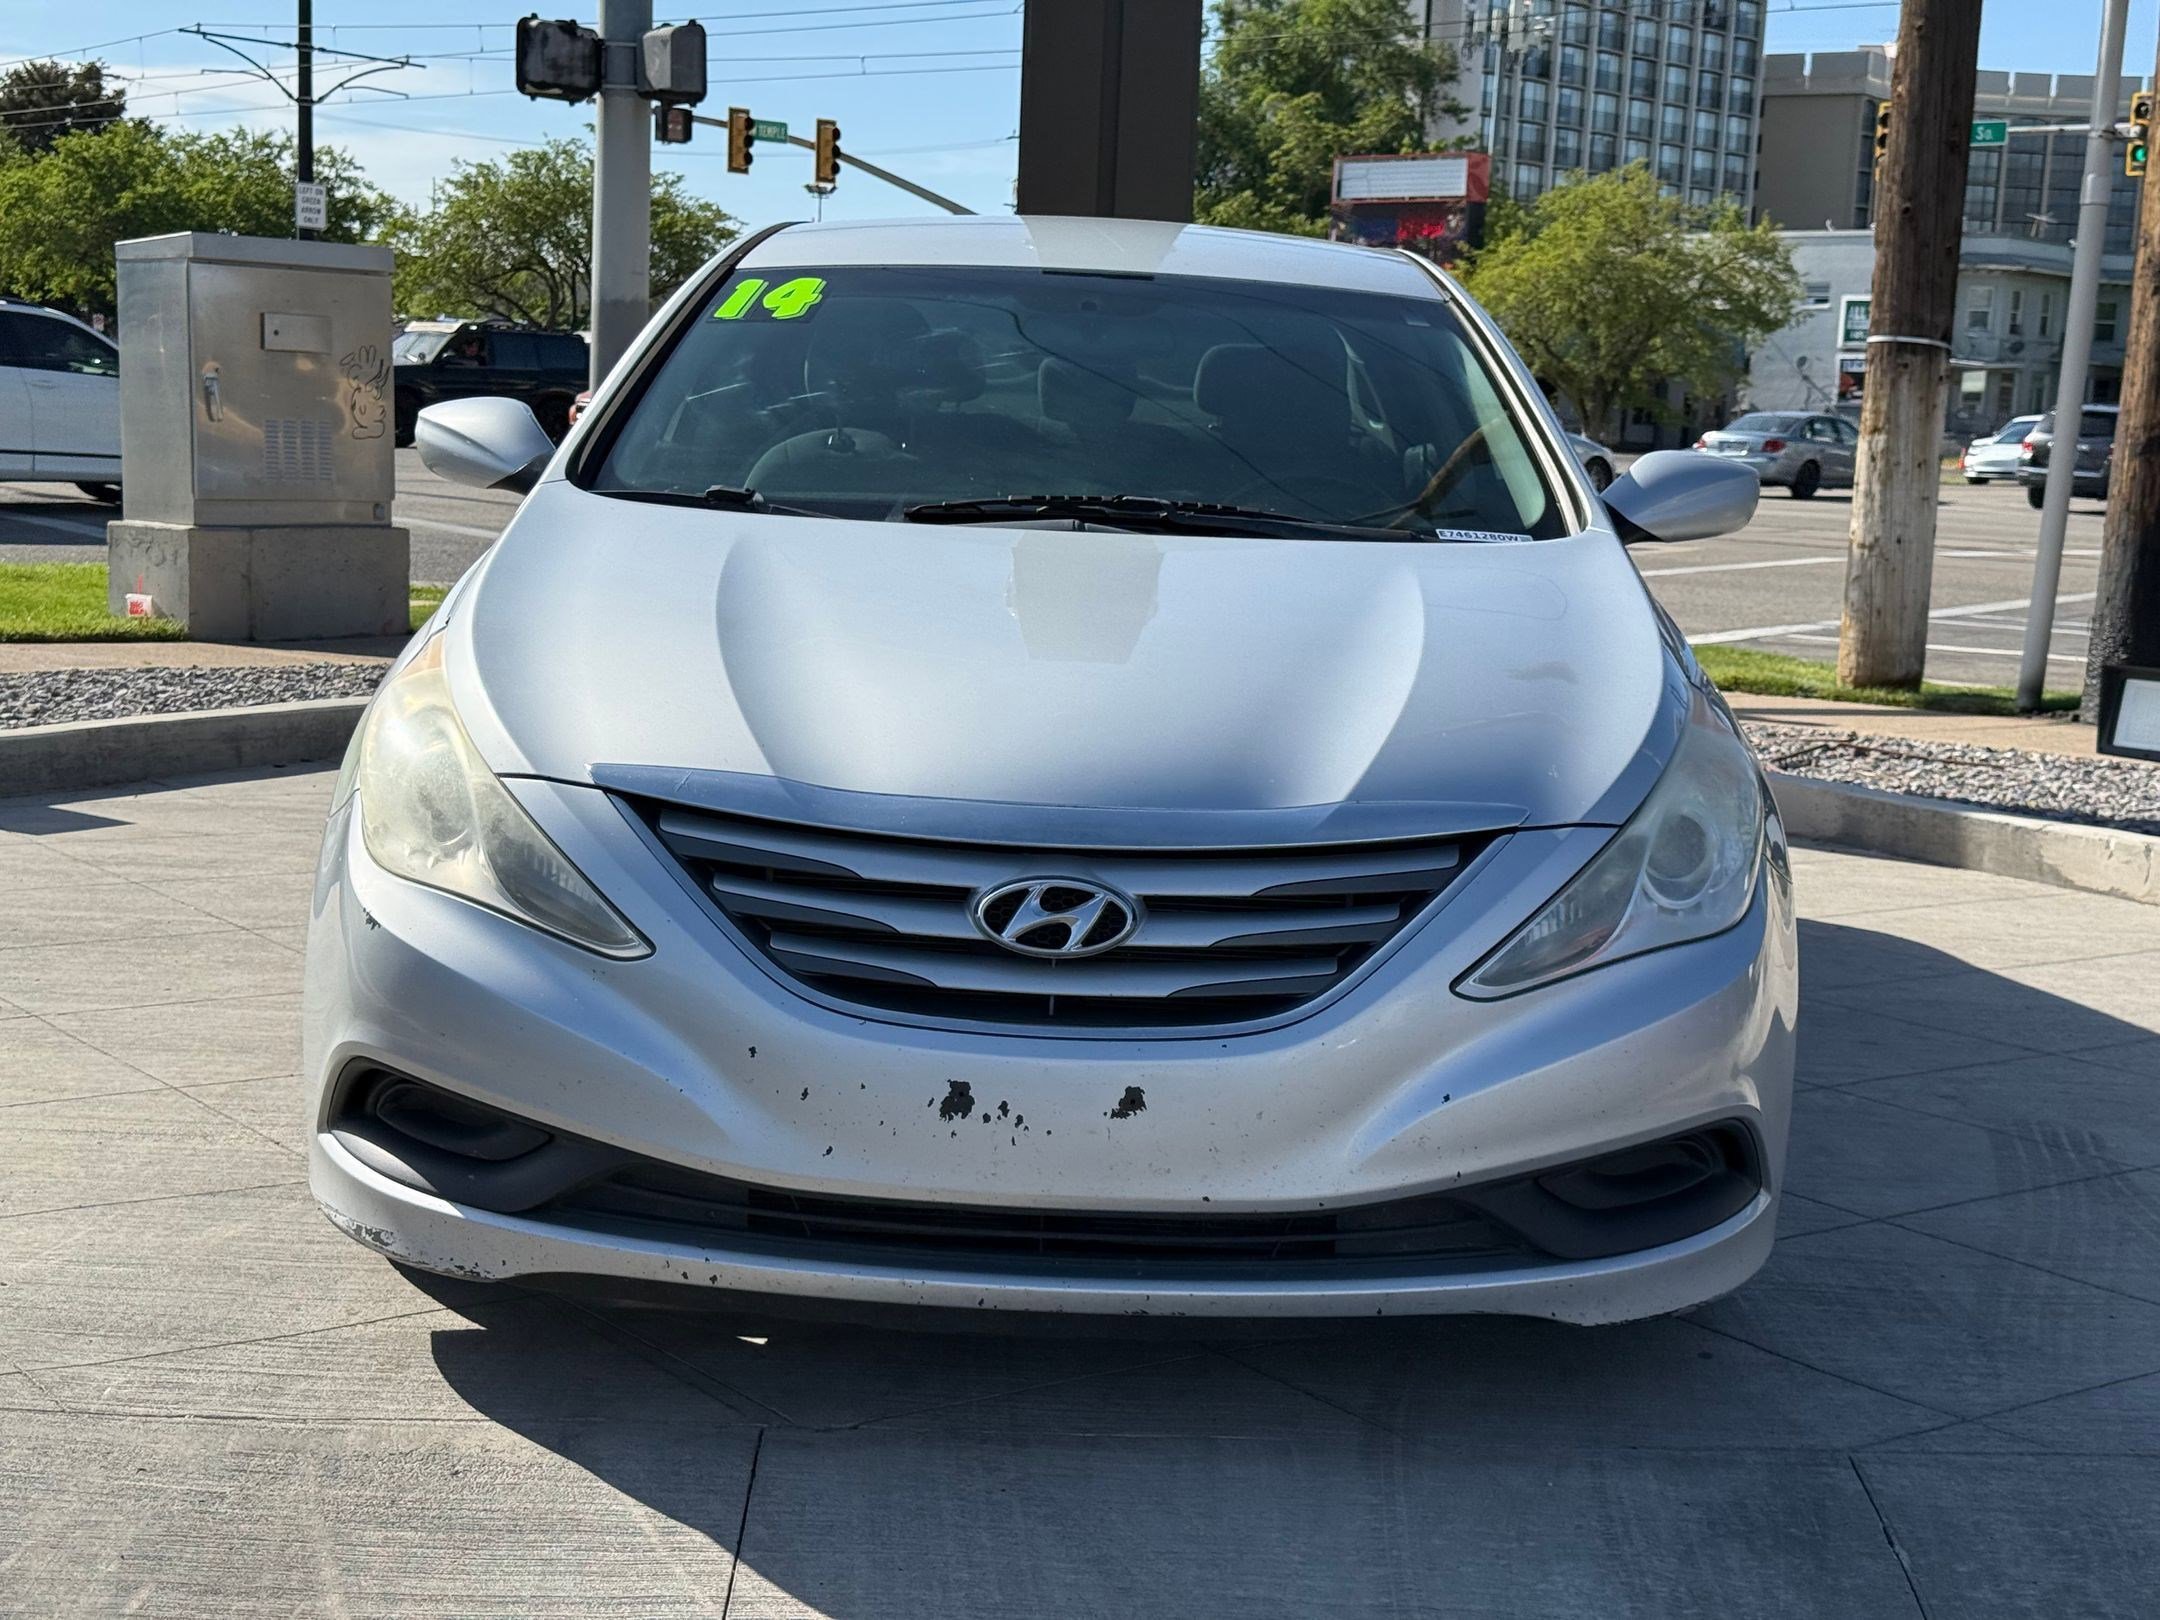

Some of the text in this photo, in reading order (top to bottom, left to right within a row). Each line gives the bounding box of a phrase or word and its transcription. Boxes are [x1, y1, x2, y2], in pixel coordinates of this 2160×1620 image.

[301, 206, 321, 215] ARROW
[304, 216, 318, 224] ONLY
[714, 277, 827, 320] 14
